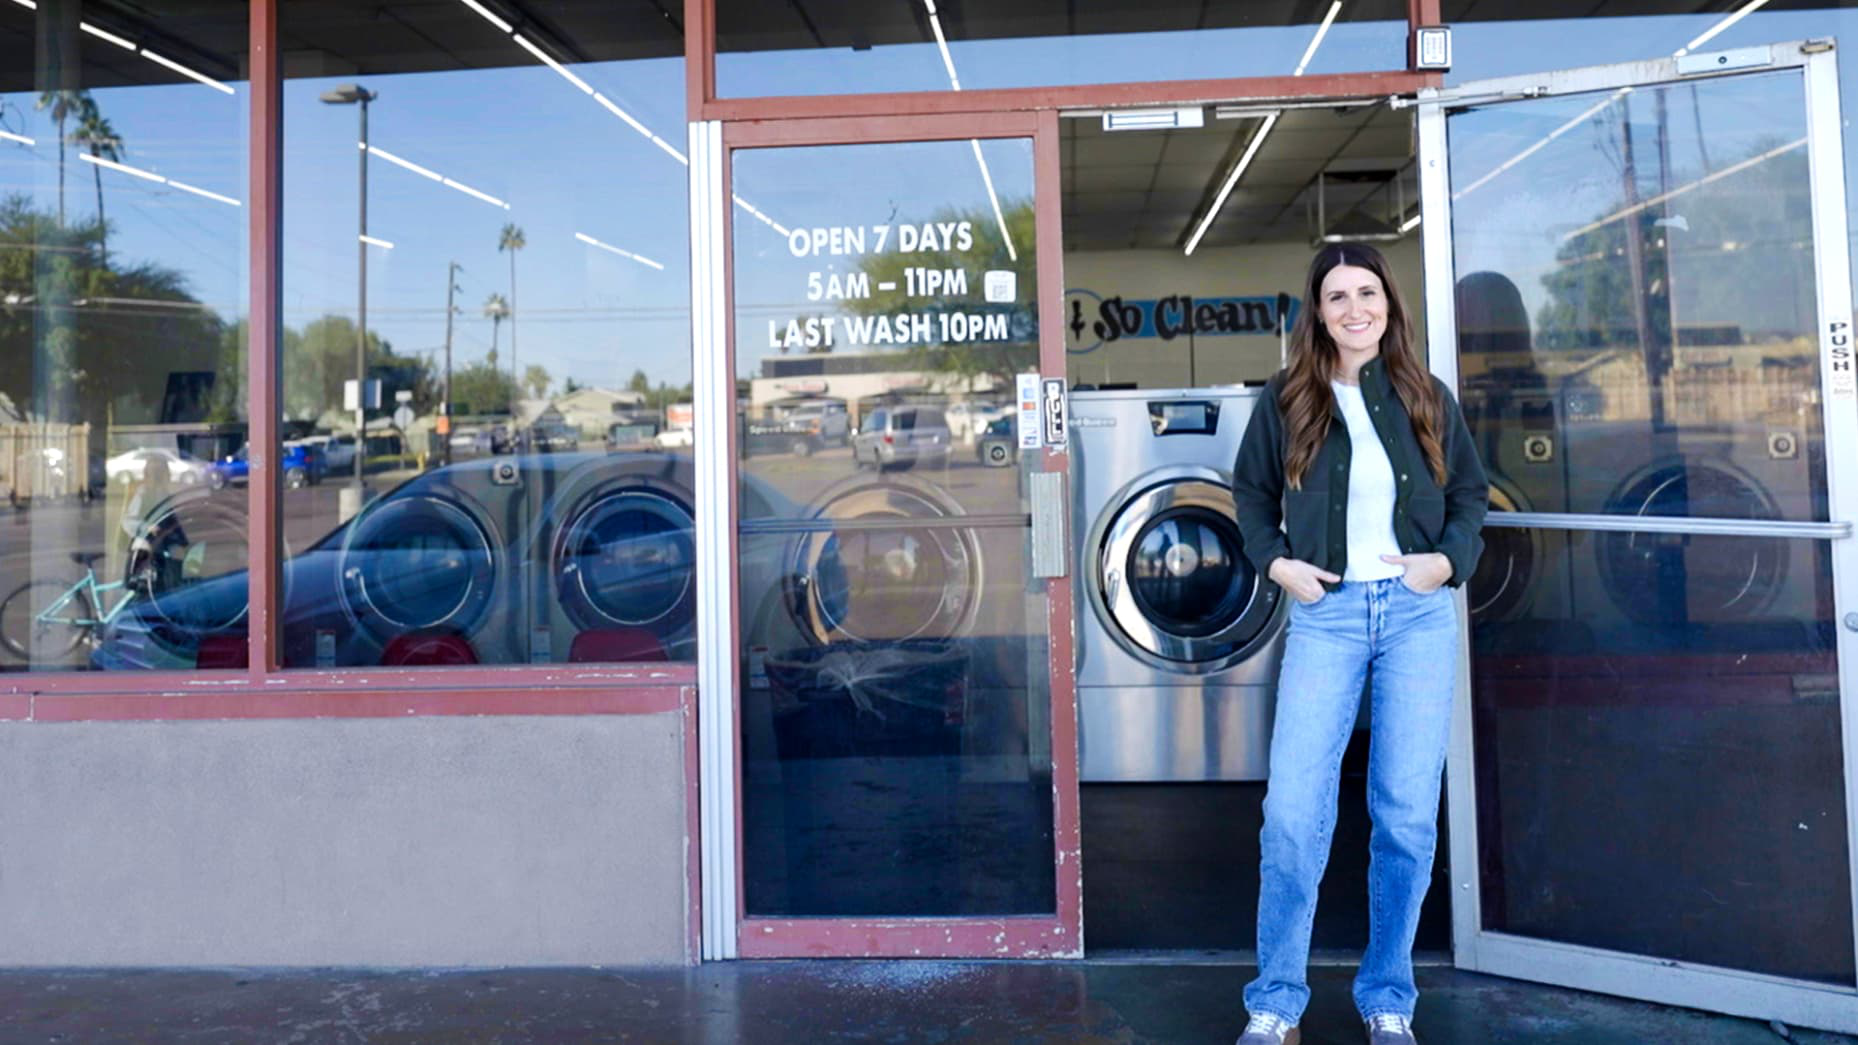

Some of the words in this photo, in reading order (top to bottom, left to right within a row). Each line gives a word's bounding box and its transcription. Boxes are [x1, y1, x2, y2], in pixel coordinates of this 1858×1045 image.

[788, 226, 865, 257] OPEN
[873, 225, 890, 254] 7
[899, 222, 973, 252] DAYS
[807, 271, 870, 300] 5AM
[904, 268, 968, 297] 11PM
[768, 317, 835, 348] LAST
[843, 313, 930, 345] WASH
[939, 312, 1008, 343] 10PM
[1093, 296, 1143, 342] So
[1155, 292, 1291, 341] Clean!
[1830, 322, 1849, 371] PUSH
